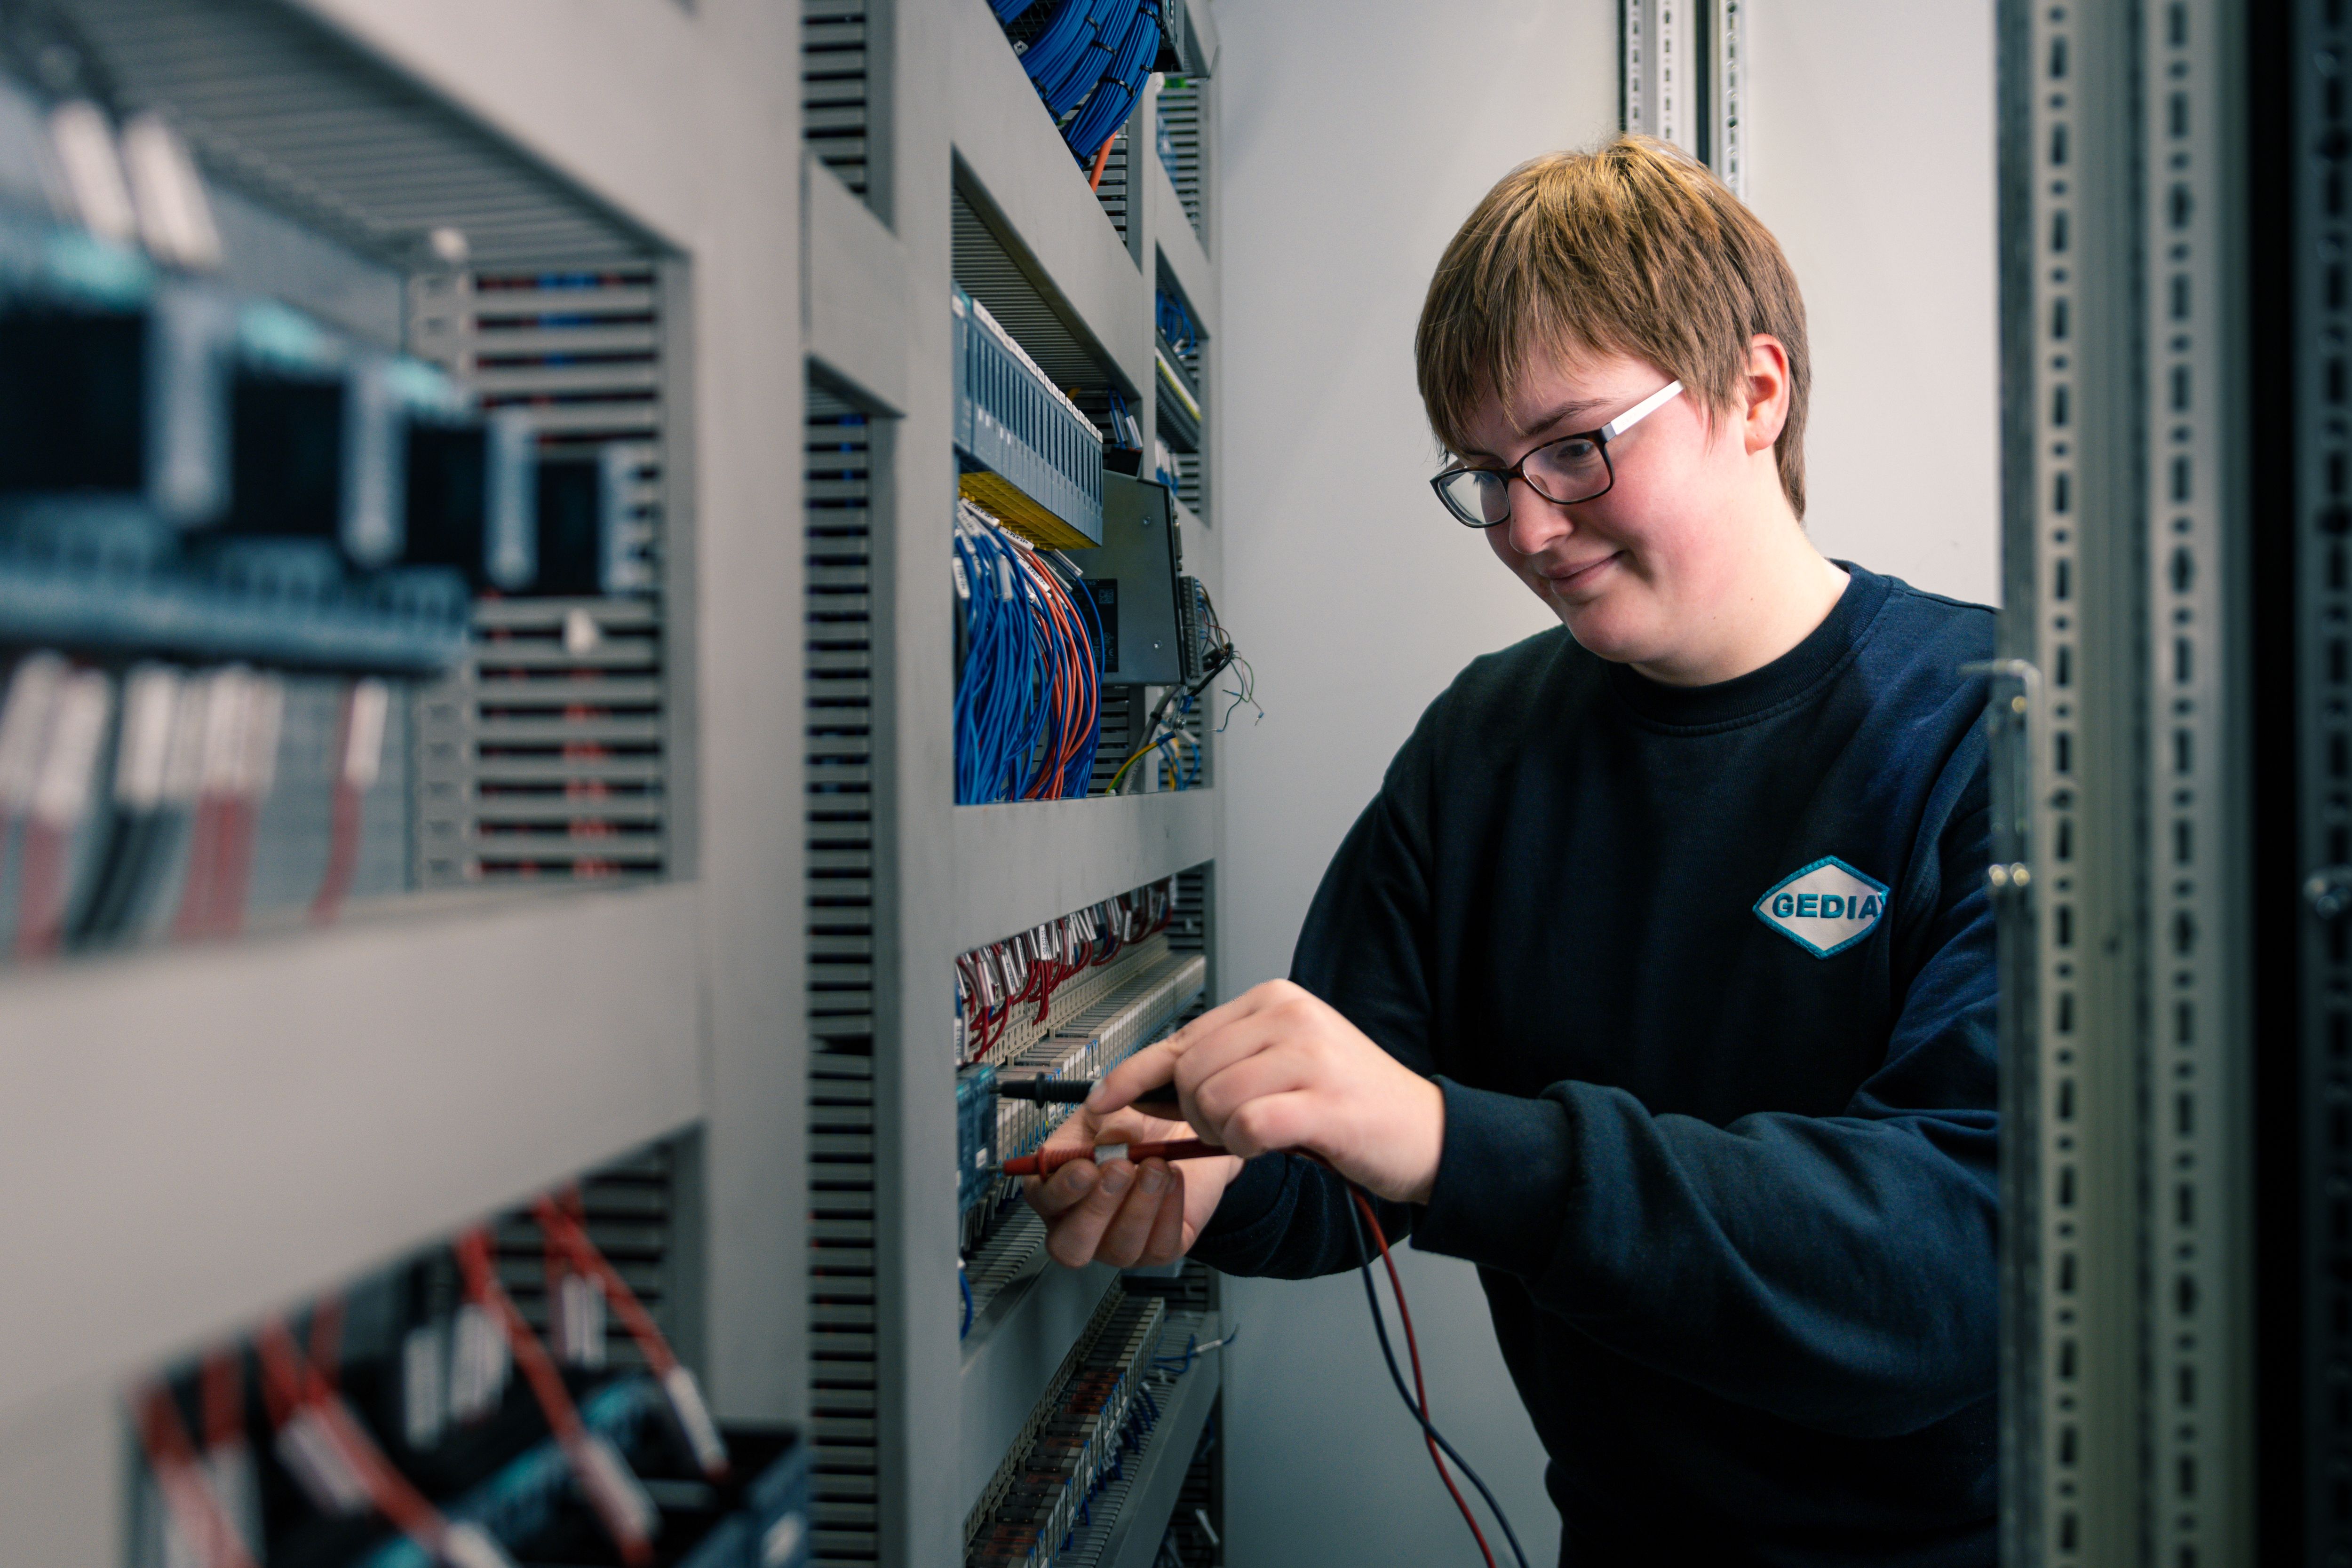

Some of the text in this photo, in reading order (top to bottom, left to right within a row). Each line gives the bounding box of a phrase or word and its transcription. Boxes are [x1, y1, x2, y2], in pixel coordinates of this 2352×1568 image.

[1006, 530, 1029, 545] =45-KS4:1
[1027, 566, 1046, 586] =45-KS4:4
[1772, 893, 1878, 920] GEDIA
